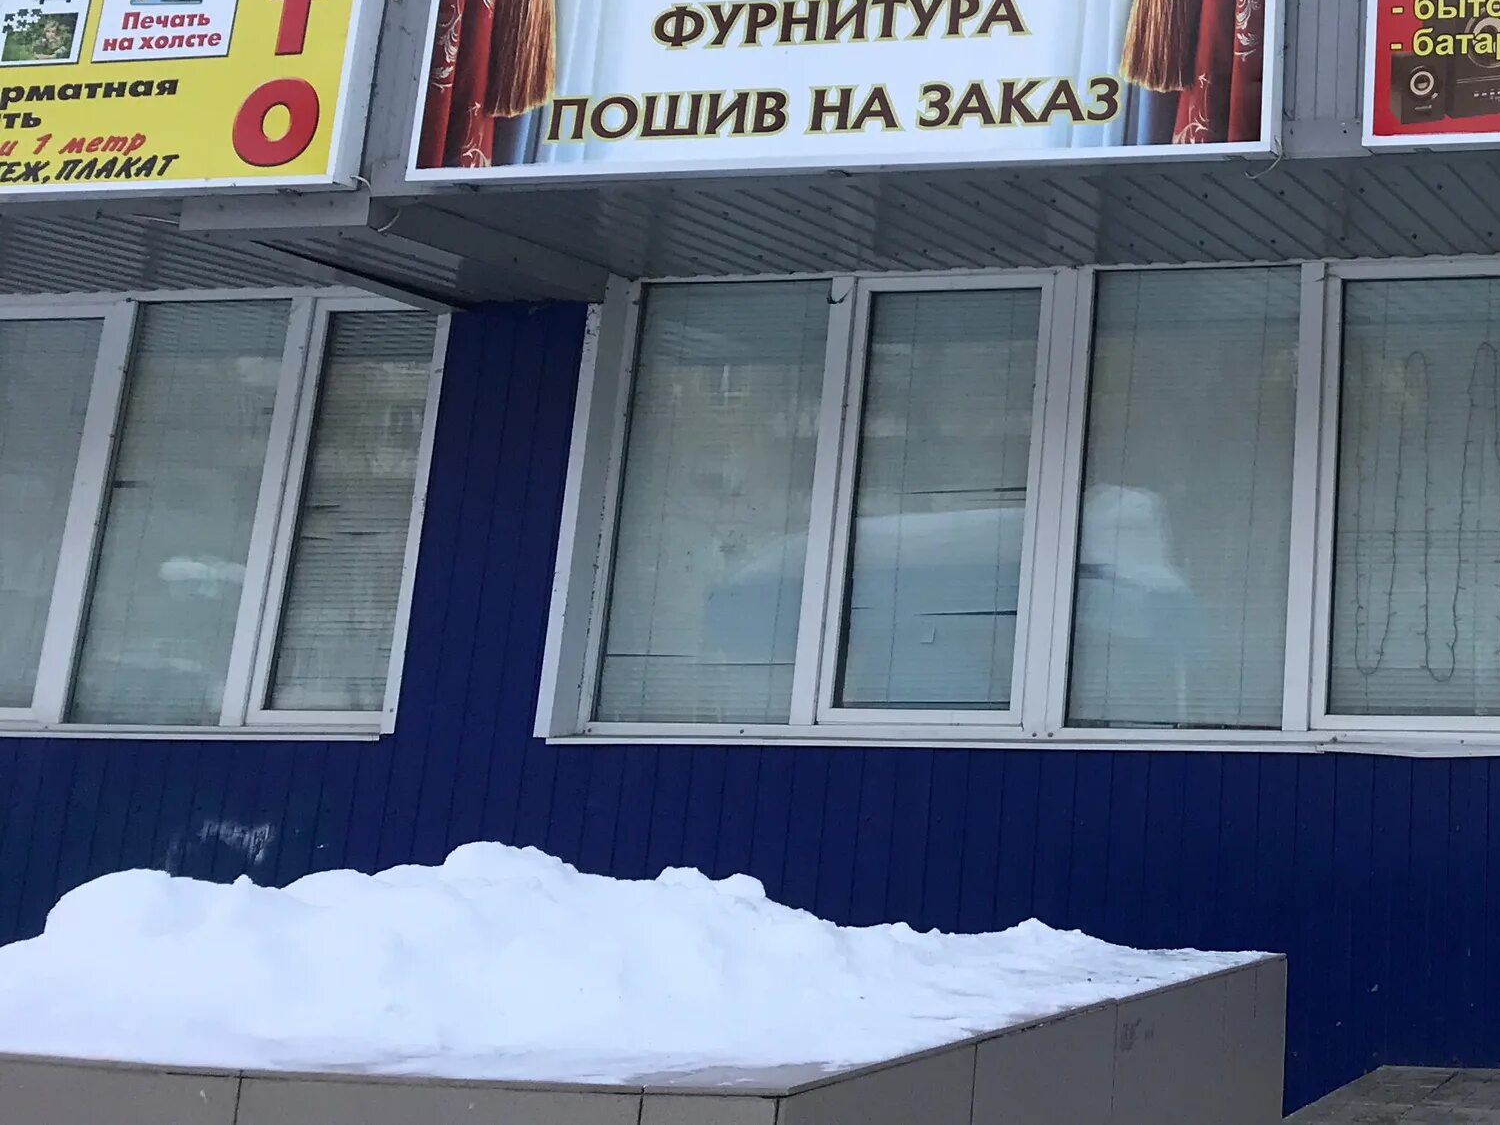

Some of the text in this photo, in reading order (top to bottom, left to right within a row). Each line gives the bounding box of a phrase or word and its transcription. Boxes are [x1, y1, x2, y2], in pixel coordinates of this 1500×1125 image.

[122, 12, 211, 30] Печать
[102, 32, 222, 52] на холсте
[544, 75, 1121, 143] ПОШИВ НА ЗАКАЗ
[0, 112, 41, 129] ть
[33, 133, 52, 155] 1
[58, 133, 146, 156] метр
